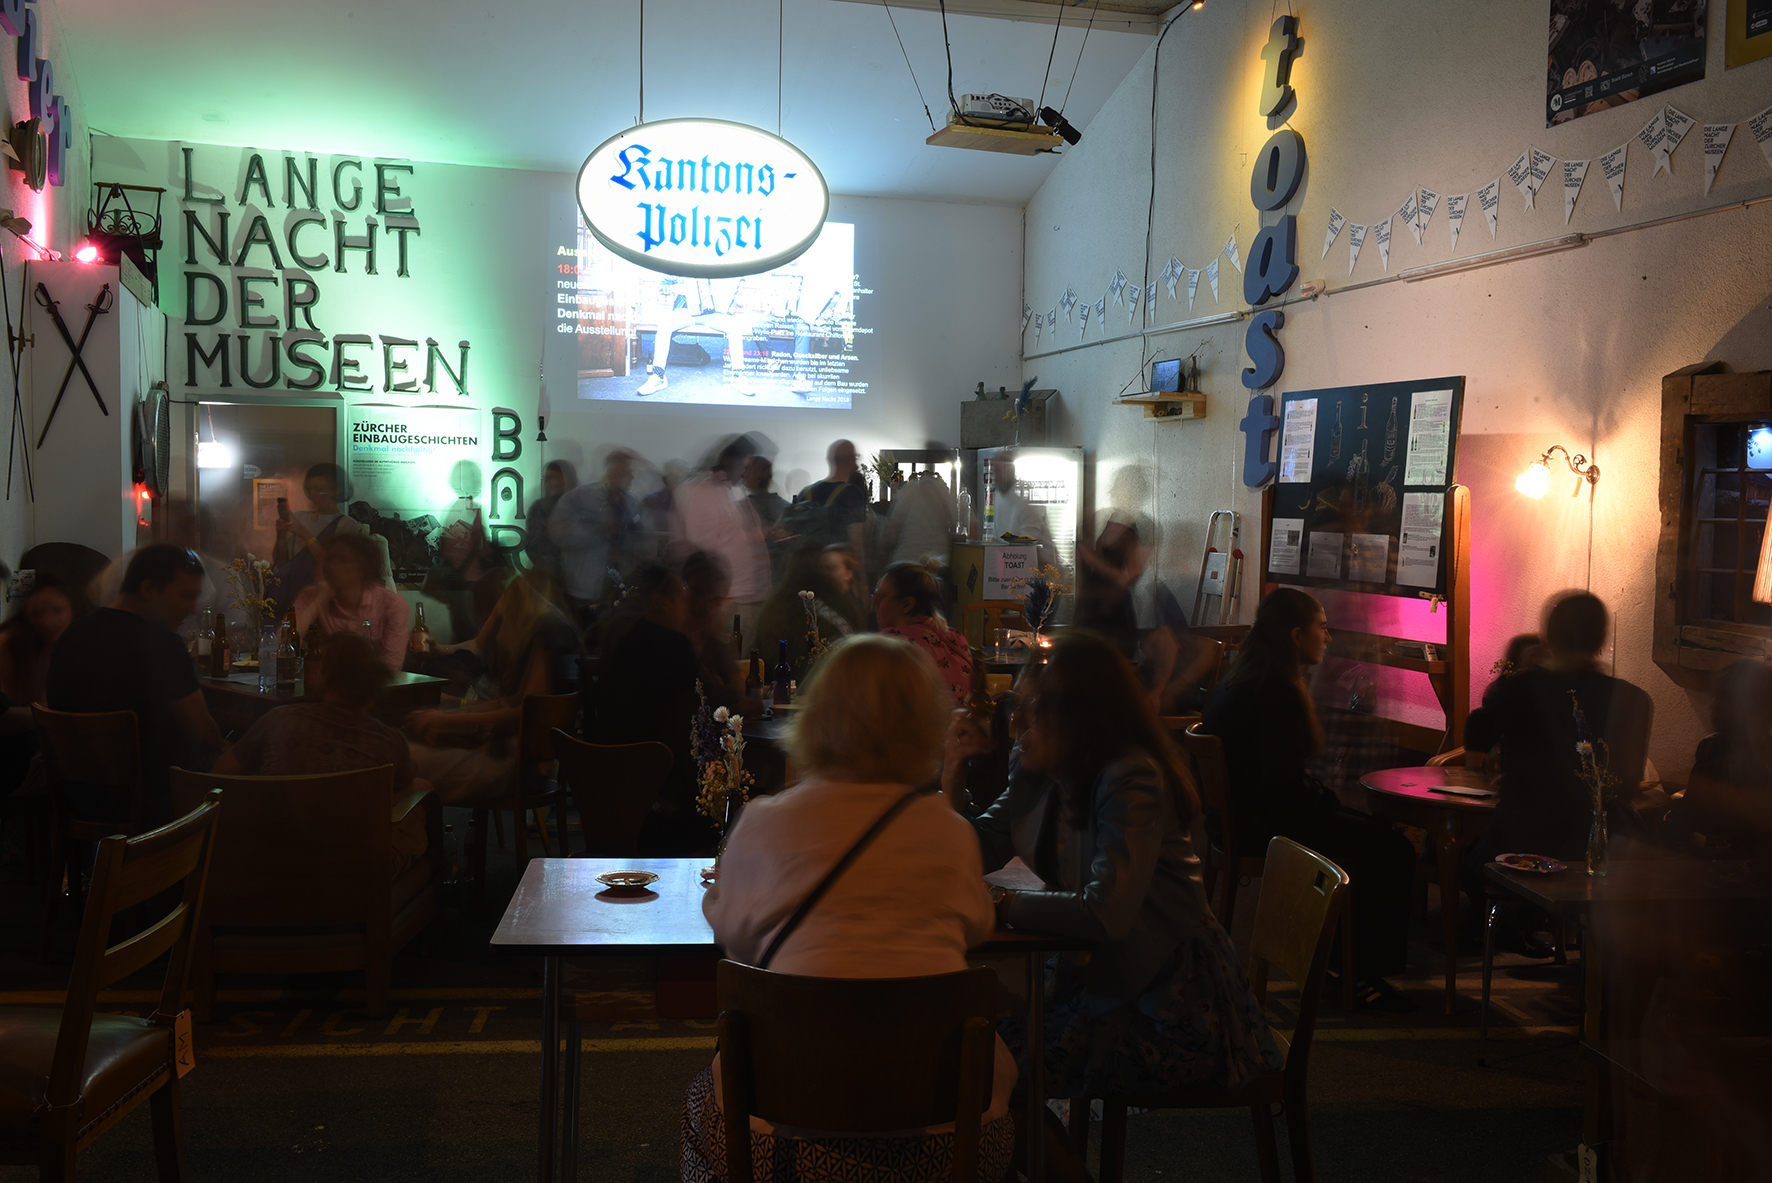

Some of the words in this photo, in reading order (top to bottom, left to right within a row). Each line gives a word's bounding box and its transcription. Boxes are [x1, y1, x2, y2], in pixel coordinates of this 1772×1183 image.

[1758, 107, 1772, 120] LANG
[1757, 128, 1772, 143] MUSEE
[608, 143, 797, 197] Kantons-
[182, 147, 414, 217] LANGE
[636, 202, 762, 257] Polizei
[183, 210, 421, 277] NACHT
[1240, 15, 1304, 487] toast
[183, 271, 321, 331] DER
[557, 308, 605, 320] Denkmal
[557, 323, 573, 334] die
[575, 324, 637, 338] Ausstellung!
[184, 332, 471, 396] MUSEEN
[353, 421, 408, 433] ZÜRCHER
[353, 434, 478, 446] EINBAUGESCHICHTEN
[392, 446, 436, 454] nachhaltig!
[1002, 552, 1027, 561] Abholung
[213, 1006, 507, 1038] SICHT
